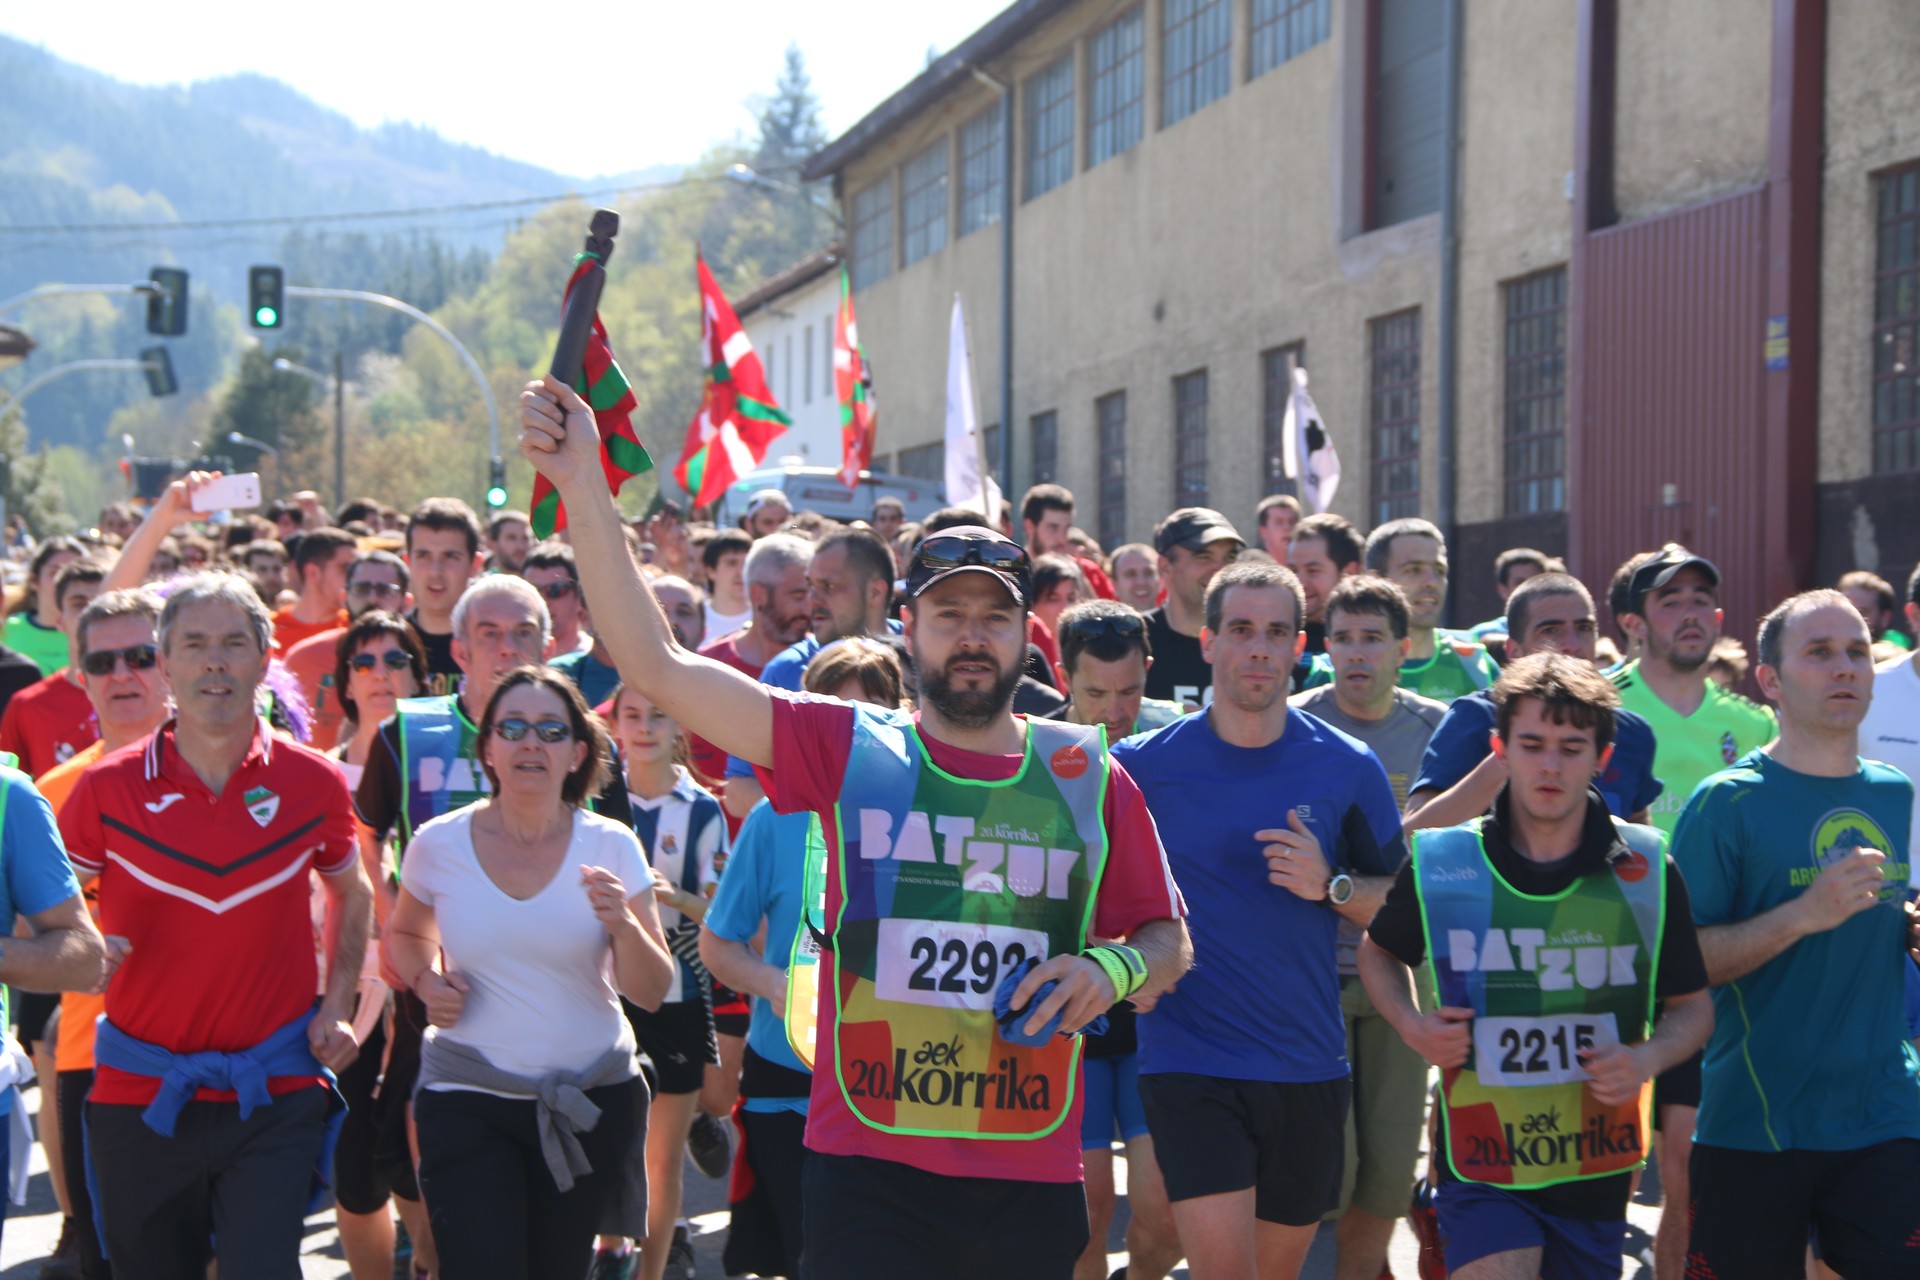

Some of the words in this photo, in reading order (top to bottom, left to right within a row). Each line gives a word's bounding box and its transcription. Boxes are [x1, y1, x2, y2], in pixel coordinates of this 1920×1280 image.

[859, 808, 975, 866] BAT
[1448, 928, 1546, 971] BAT
[1538, 944, 1639, 991] ZUK
[1500, 1024, 1595, 1073] 2215
